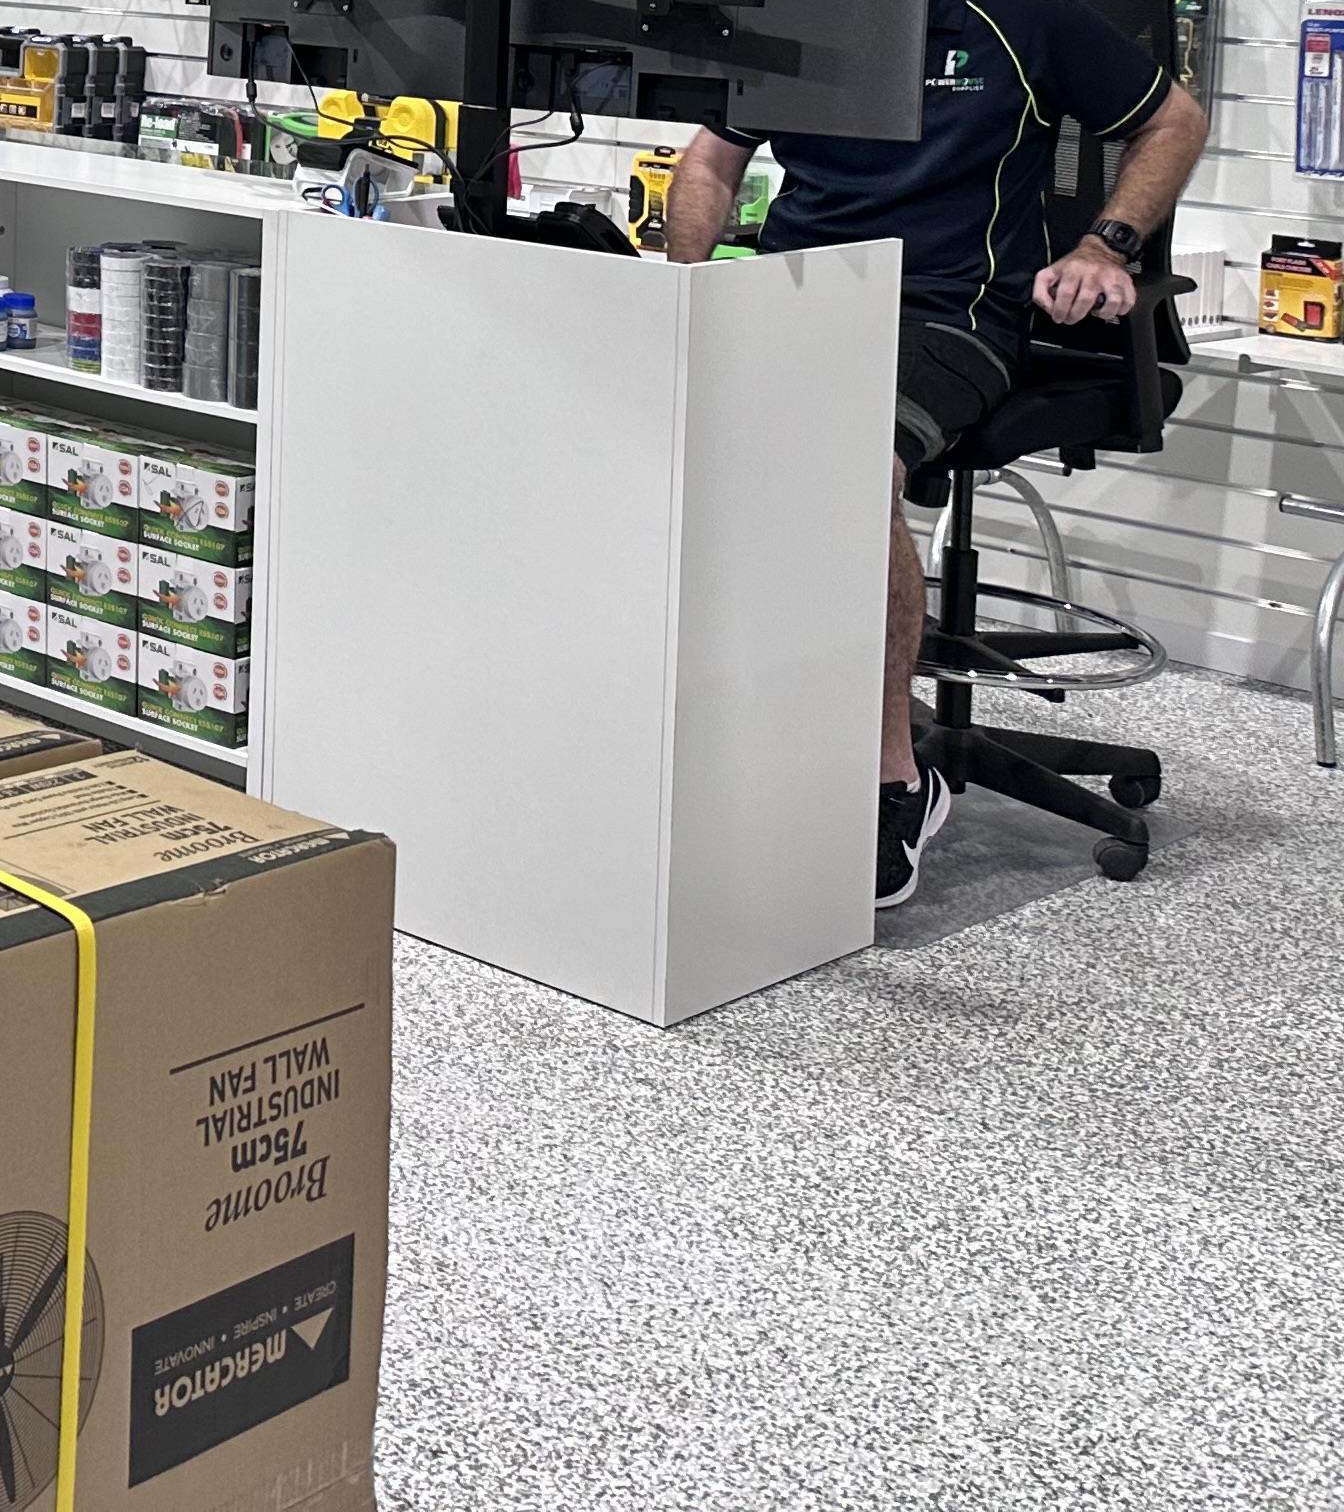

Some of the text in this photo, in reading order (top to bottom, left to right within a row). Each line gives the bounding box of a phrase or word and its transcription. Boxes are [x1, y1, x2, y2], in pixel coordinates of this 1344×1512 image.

[58, 442, 80, 458] SAL
[150, 463, 172, 479] SAL
[148, 642, 171, 658] SAL
[208, 1036, 331, 1107] WALL FAN
[196, 1068, 341, 1147] INDUSTRIAL
[231, 1120, 308, 1173] 75cm
[203, 1154, 331, 1232] Broome
[153, 1279, 338, 1377] CREATE INSPIRE INNOVATE
[154, 1328, 288, 1418] MERCATOR
